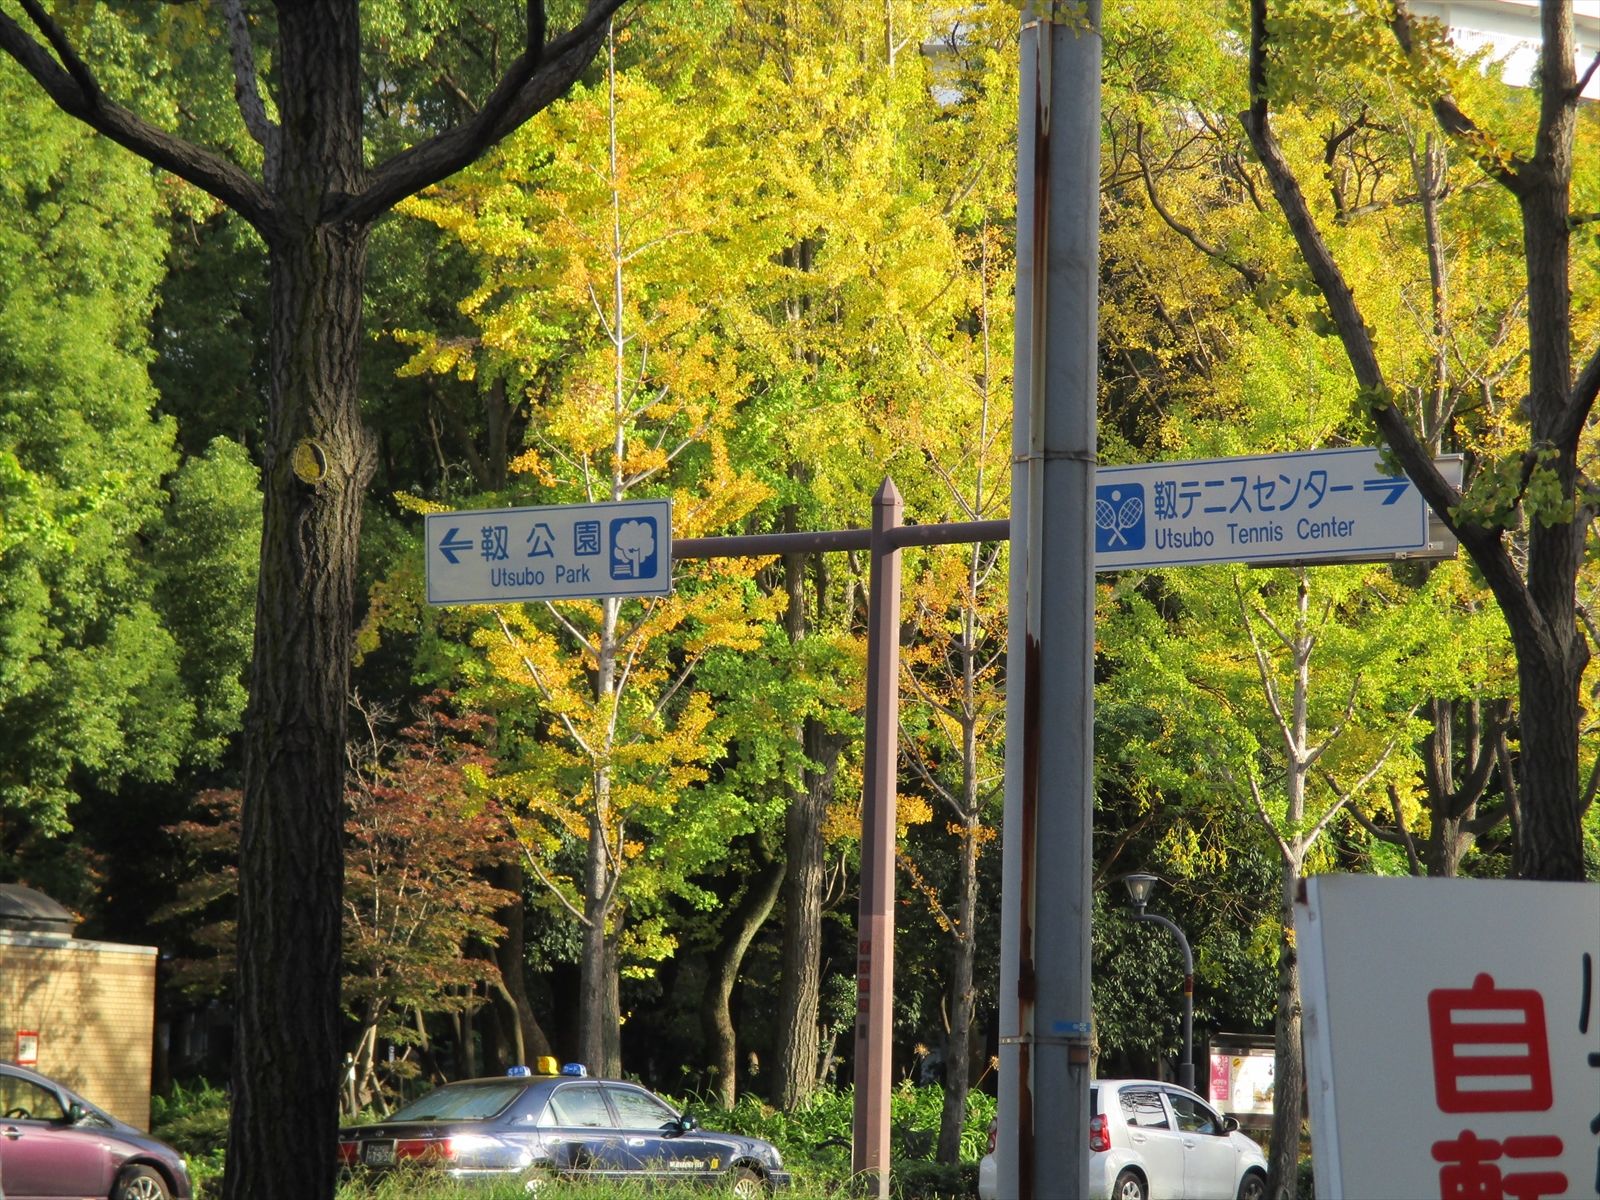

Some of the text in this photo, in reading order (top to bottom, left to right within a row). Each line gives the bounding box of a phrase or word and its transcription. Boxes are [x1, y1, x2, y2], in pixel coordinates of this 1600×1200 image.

[1154, 517, 1355, 550] Utsubo Tennis Center
[491, 564, 591, 587] Utsubo Park
